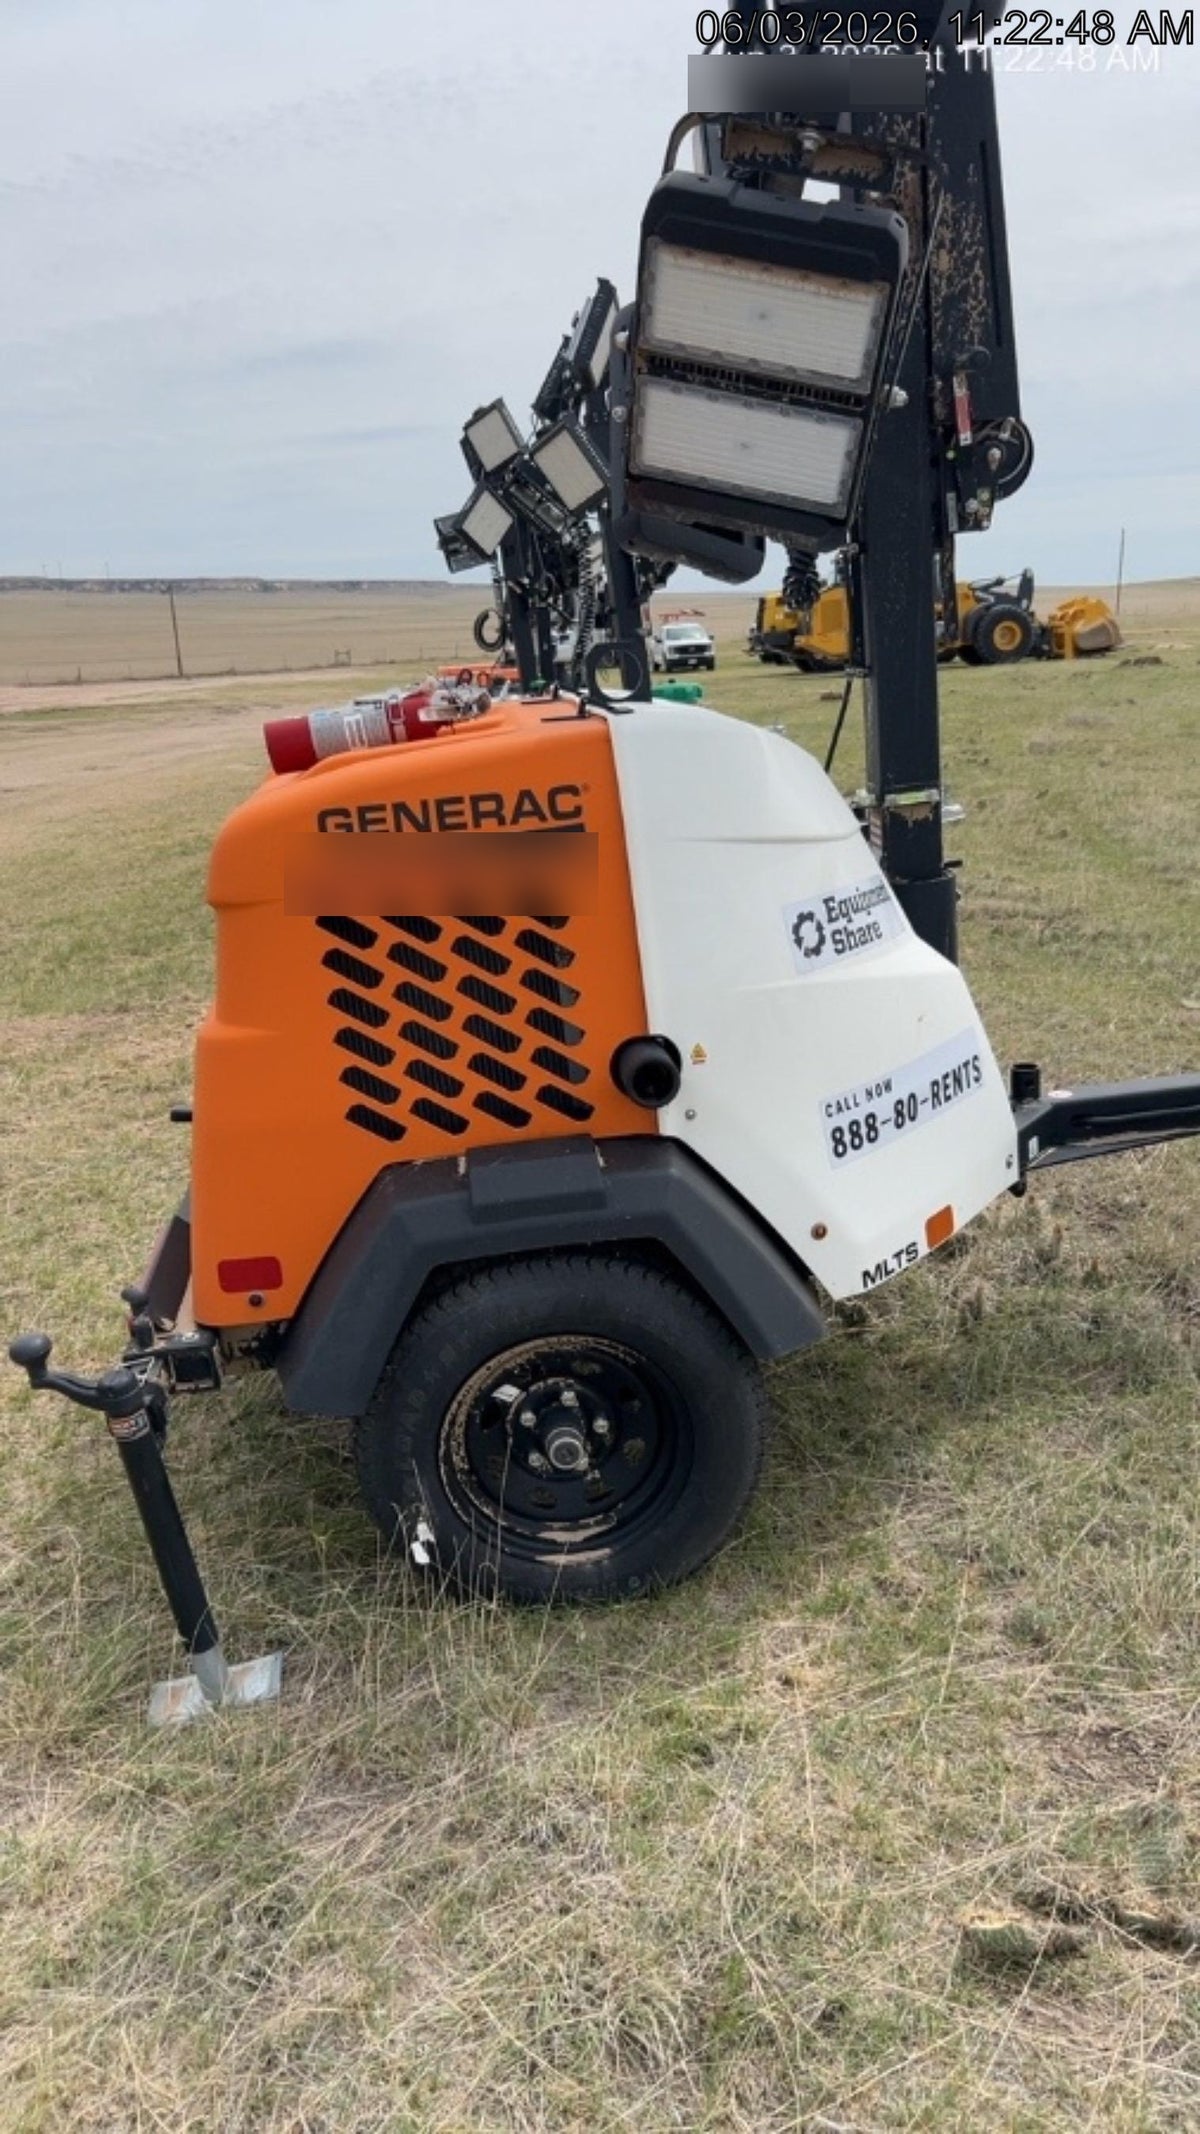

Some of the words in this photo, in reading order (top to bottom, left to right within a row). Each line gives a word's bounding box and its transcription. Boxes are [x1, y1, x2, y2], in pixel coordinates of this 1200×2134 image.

[316, 784, 583, 833] GENERAC
[822, 884, 891, 923] Equip
[830, 921, 883, 956] Share
[825, 1092, 860, 1118] CALL
[865, 1078, 893, 1102] NOW
[831, 1054, 983, 1158] 888-80-RENTS
[862, 1241, 919, 1289] MLTS
